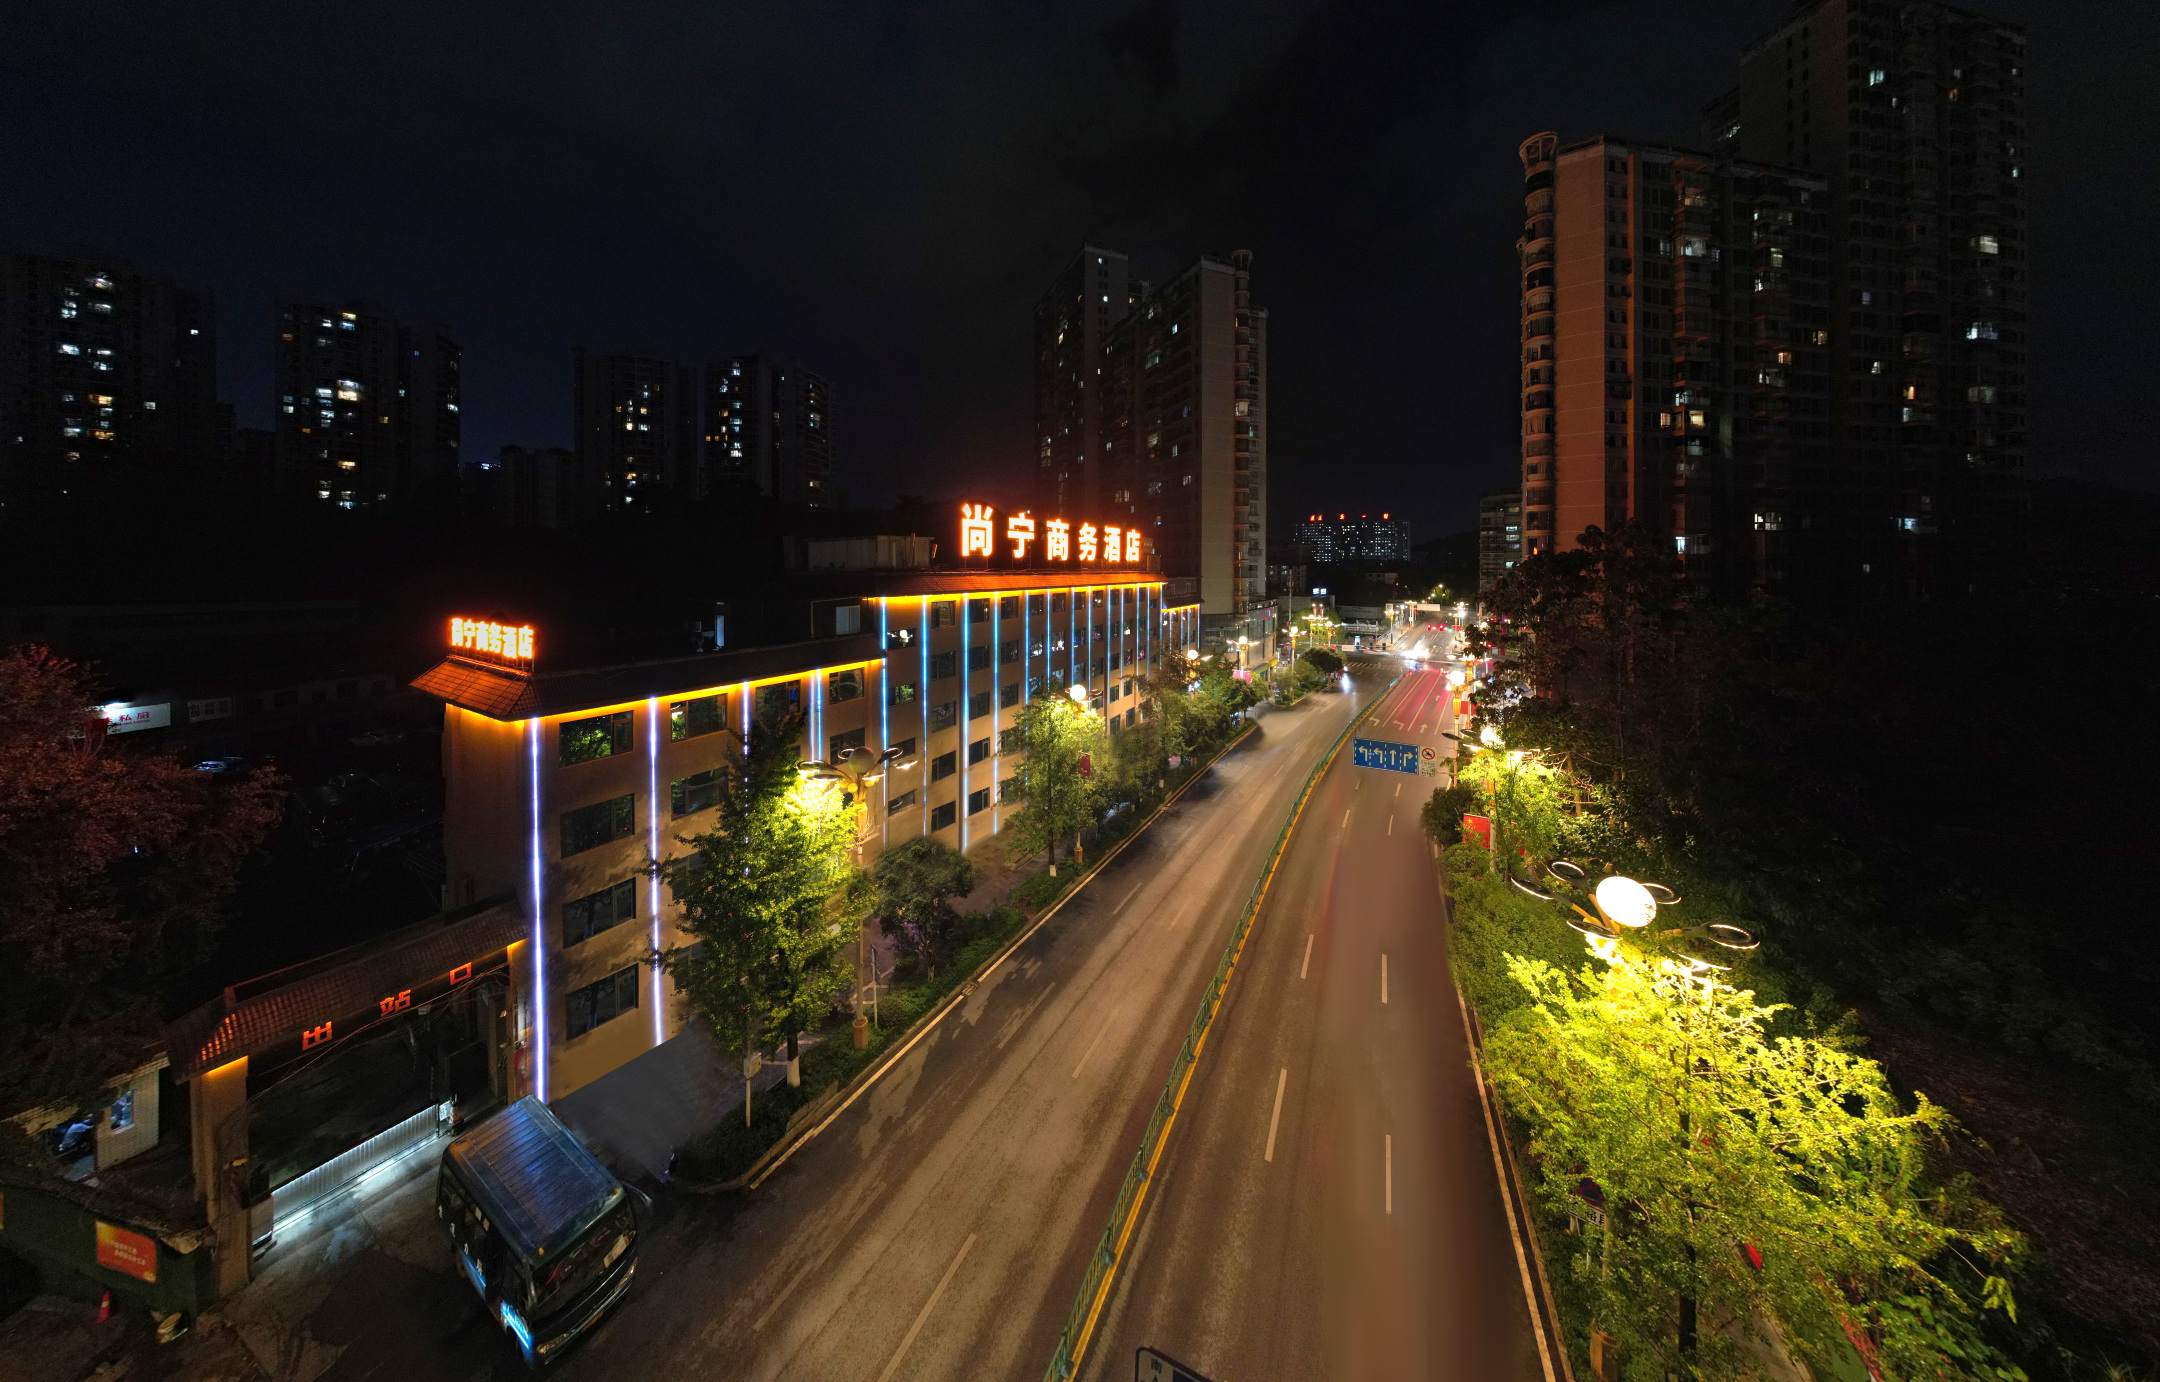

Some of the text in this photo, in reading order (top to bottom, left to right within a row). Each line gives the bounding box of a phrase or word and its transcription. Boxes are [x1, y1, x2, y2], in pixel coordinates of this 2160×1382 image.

[962, 503, 1141, 562] 尚宁商务酒店
[451, 617, 534, 659] 尚宁商务酒店
[302, 962, 472, 1051] 出站口
